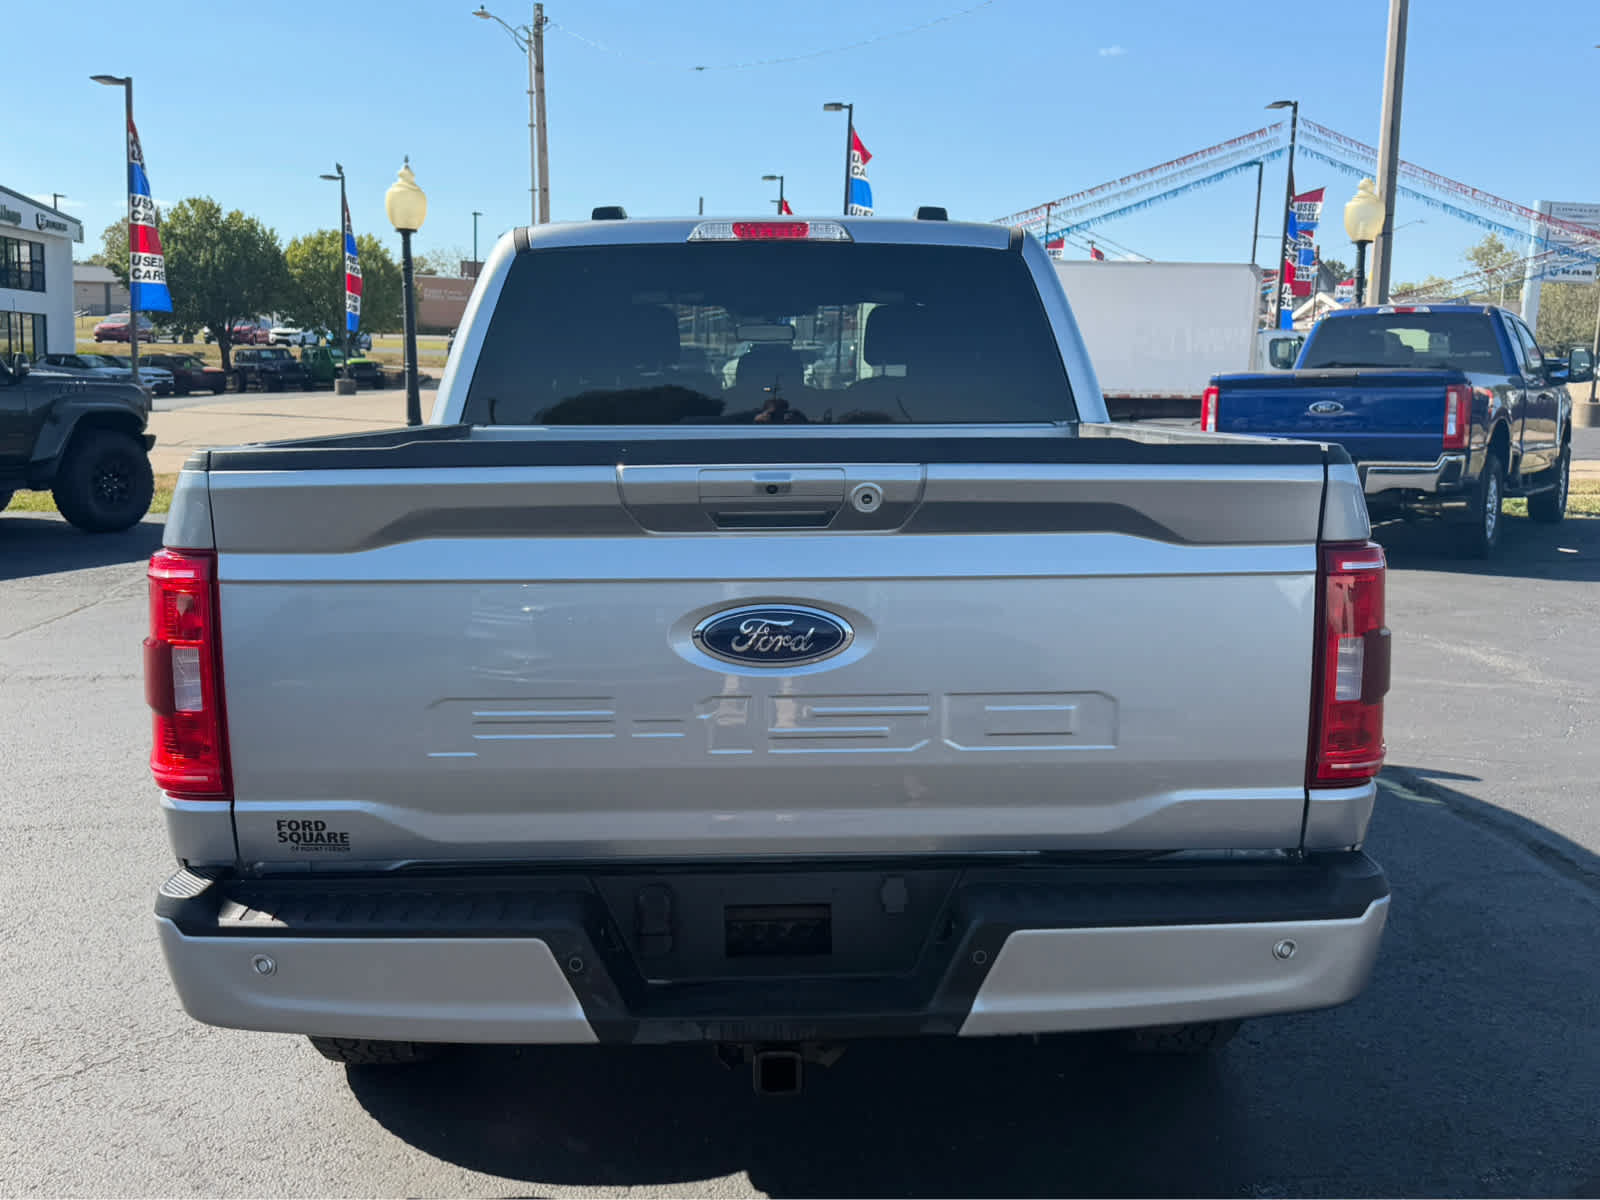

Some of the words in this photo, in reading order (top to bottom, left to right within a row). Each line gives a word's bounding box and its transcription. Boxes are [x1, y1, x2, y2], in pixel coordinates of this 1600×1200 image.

[131, 254, 163, 267] USED
[131, 268, 165, 283] CARS
[731, 618, 815, 652] Ford
[426, 690, 1120, 758] F-150
[276, 820, 327, 832] FORD
[277, 832, 351, 846] SQUARE
